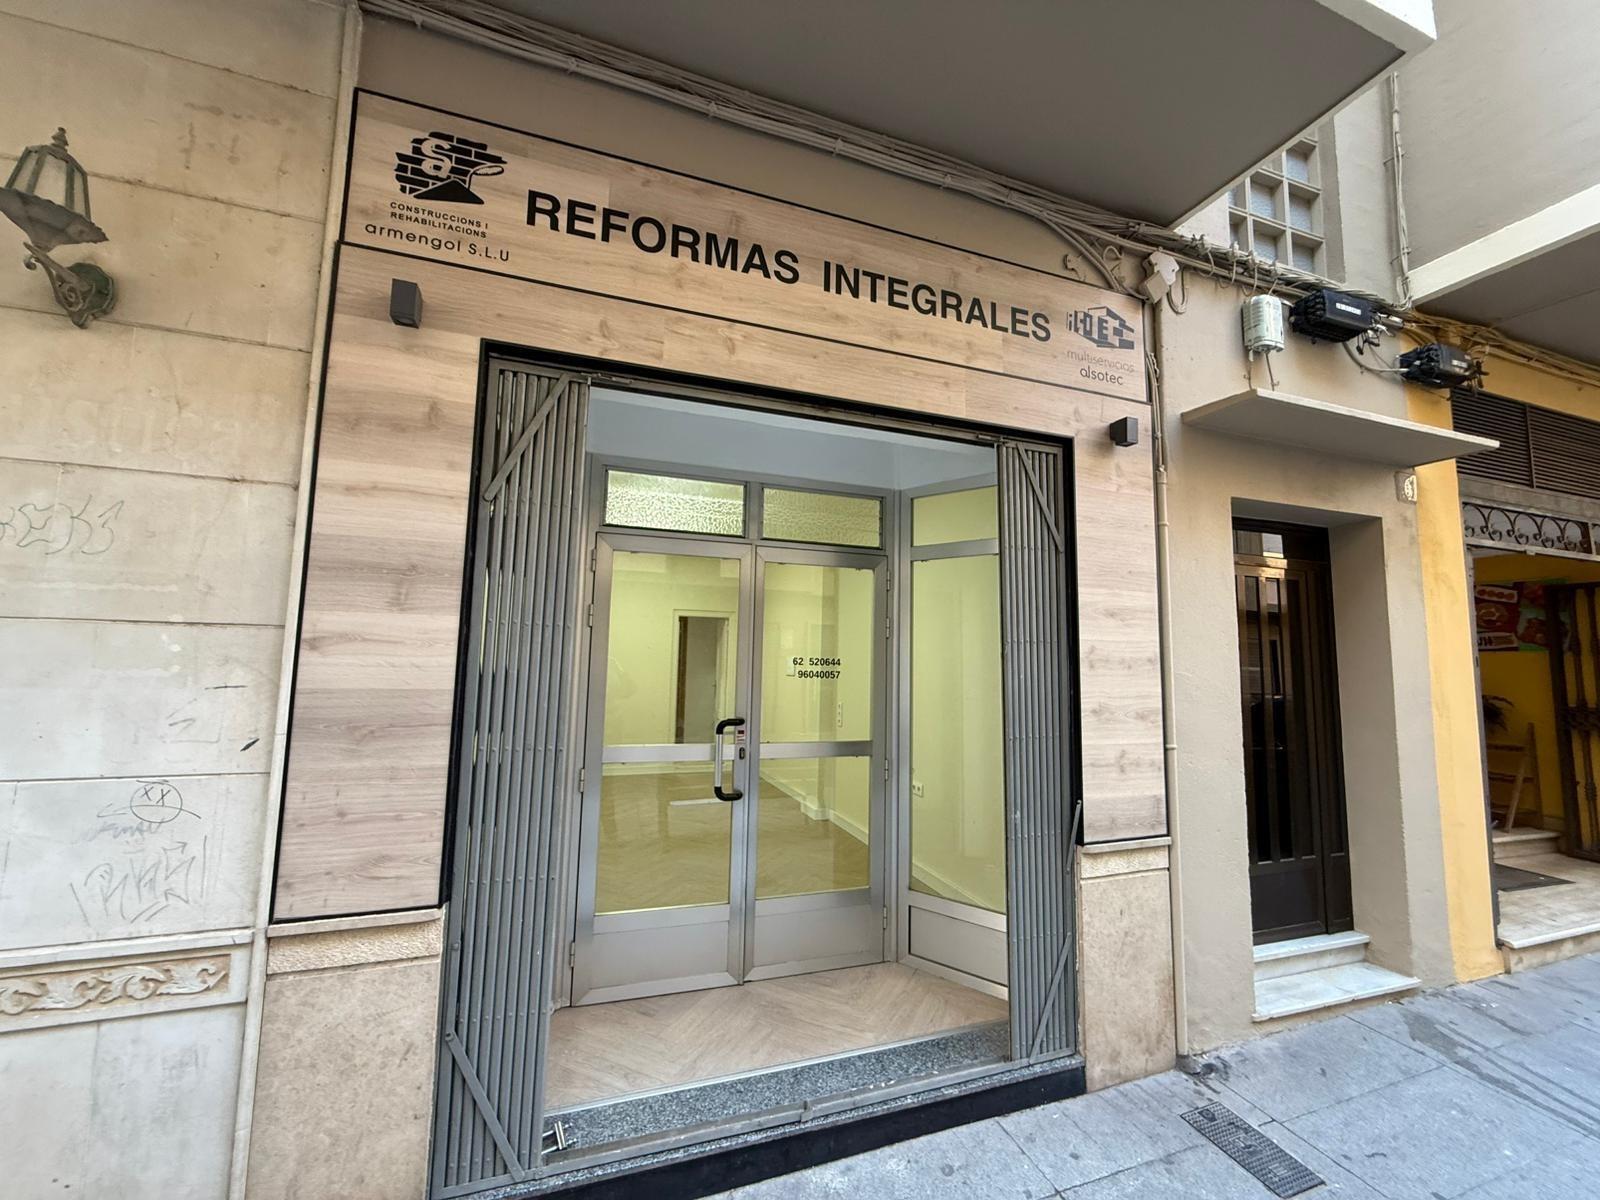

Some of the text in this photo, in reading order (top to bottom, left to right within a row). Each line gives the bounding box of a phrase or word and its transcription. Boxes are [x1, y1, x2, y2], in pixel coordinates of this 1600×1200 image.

[390, 201, 482, 229] CONSTRUCCIONS
[390, 211, 487, 239] REHABILITACIONS
[364, 223, 510, 262] armengol S.L.U
[526, 188, 1052, 343] REFORMAS INTEGRALES
[1079, 365, 1124, 386] alsotec
[792, 656, 840, 666] 62 520644
[798, 670, 840, 679] 96040057
